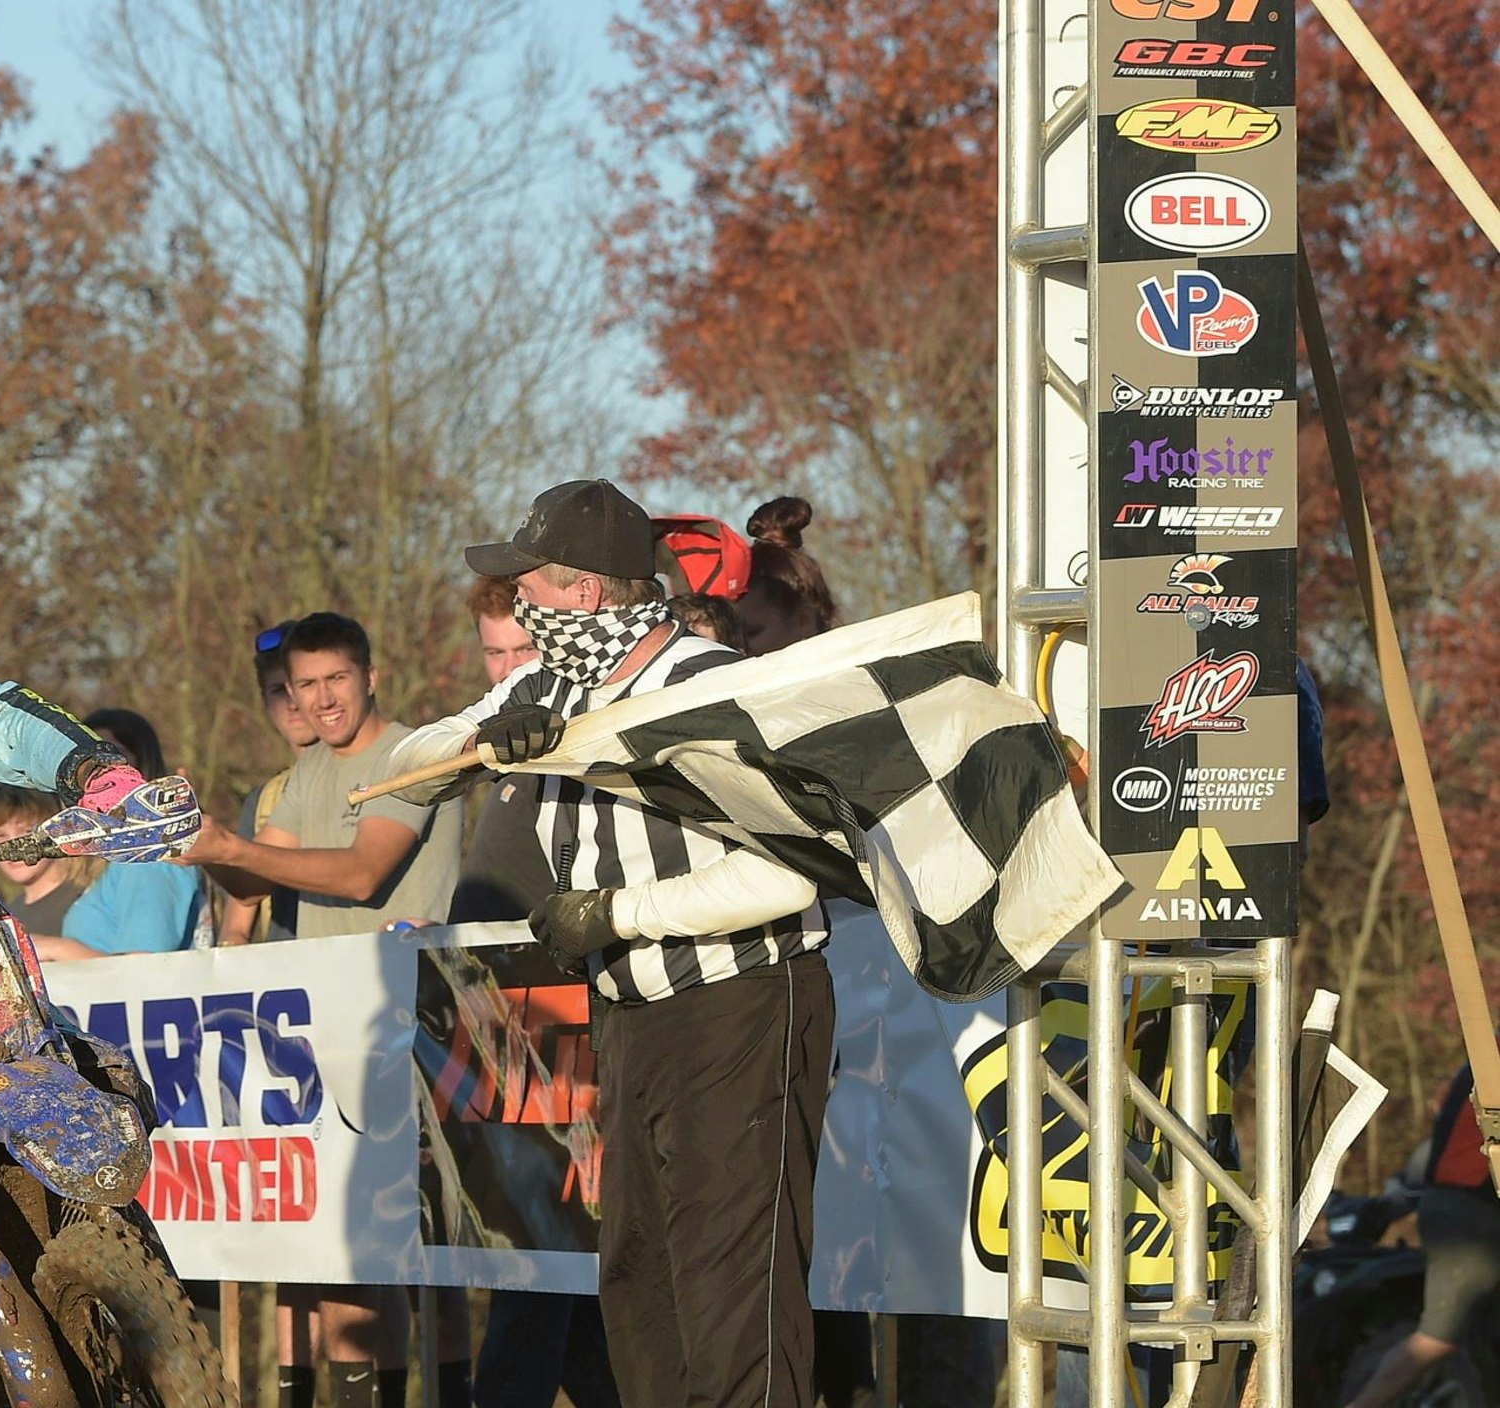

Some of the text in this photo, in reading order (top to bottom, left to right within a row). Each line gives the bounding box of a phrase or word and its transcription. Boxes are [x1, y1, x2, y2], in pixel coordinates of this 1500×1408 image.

[1117, 40, 1277, 67] GBC
[1117, 67, 1255, 79] PERFORMANCE MOTORSPORTS TIRES
[1118, 106, 1278, 139] FMF
[1151, 195, 1247, 226] BELL
[1142, 274, 1221, 351] VP
[1195, 313, 1261, 338] Racing
[1197, 340, 1237, 350] FUELS
[1144, 387, 1283, 406] DUNLOP
[1140, 406, 1272, 418] MOTORCYCLE TIRES
[1123, 436, 1275, 484] Hoosier
[1168, 477, 1265, 489] RACING TIRE
[1164, 528, 1270, 536] Performance Products
[1138, 595, 1183, 612] ALL
[1211, 611, 1260, 629] Racing
[1184, 767, 1286, 782] MOTORCYCLE
[1121, 781, 1162, 799] MMI
[1182, 782, 1275, 797] MECHANICS
[1179, 797, 1262, 811] INSTITUTE
[1138, 897, 1263, 921] ARMA
[61, 987, 324, 1130] ARTS
